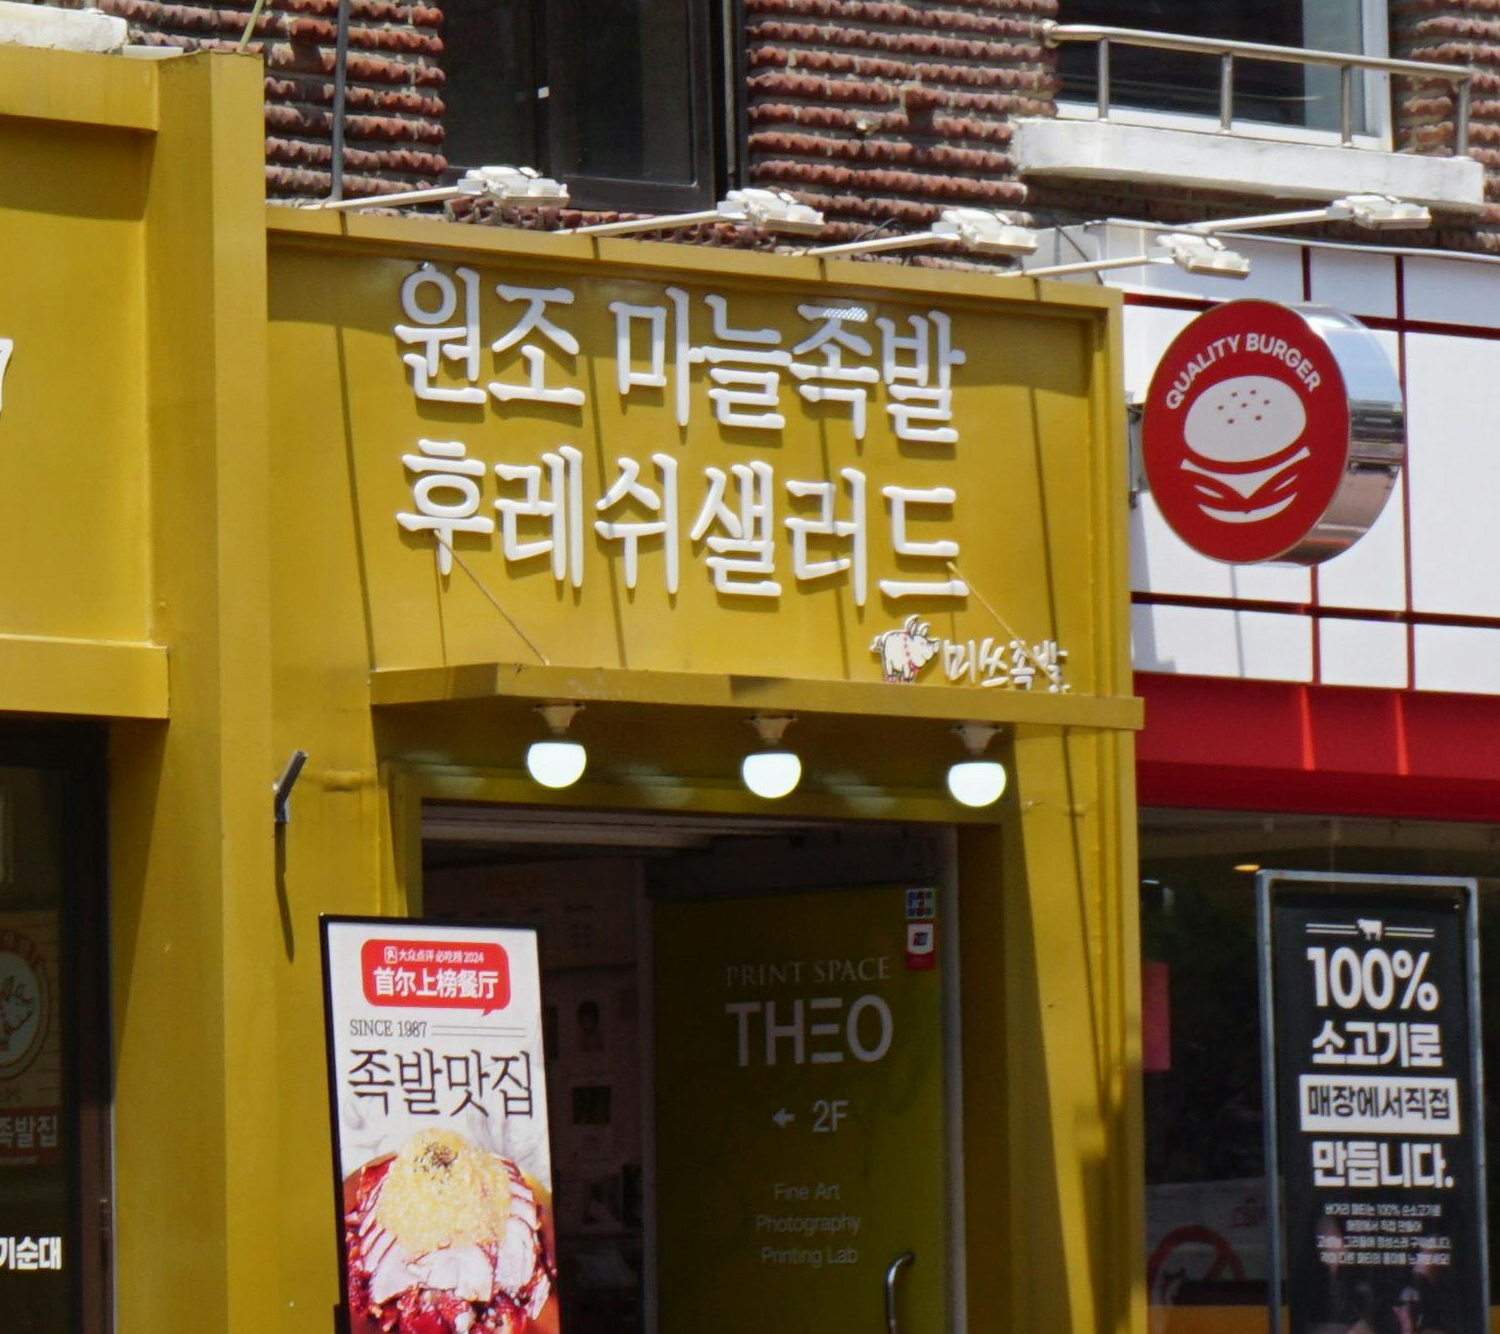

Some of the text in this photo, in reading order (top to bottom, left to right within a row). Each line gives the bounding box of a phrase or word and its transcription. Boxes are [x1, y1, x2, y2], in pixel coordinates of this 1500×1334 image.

[395, 265, 966, 443] 원조 마늘족발
[1166, 333, 1321, 410] QUALITY BURGER
[396, 439, 970, 607] 후레쉬샐러드
[464, 952, 484, 964] 2024
[725, 957, 890, 988] PRINT SPACE
[373, 967, 499, 999] 首尔上榜餐厅
[1307, 947, 1440, 1011] 100%
[349, 1019, 427, 1038] SINCE 1987
[725, 994, 893, 1066] THEO
[1312, 1020, 1443, 1067] 소고기로
[348, 1047, 534, 1119] 족발맛집
[812, 1100, 848, 1132] 2F
[1312, 1140, 1454, 1188] 만듭니다.
[774, 1183, 840, 1201] Fine Art
[757, 1213, 860, 1235] Photography
[762, 1246, 858, 1267] Printing Lab
